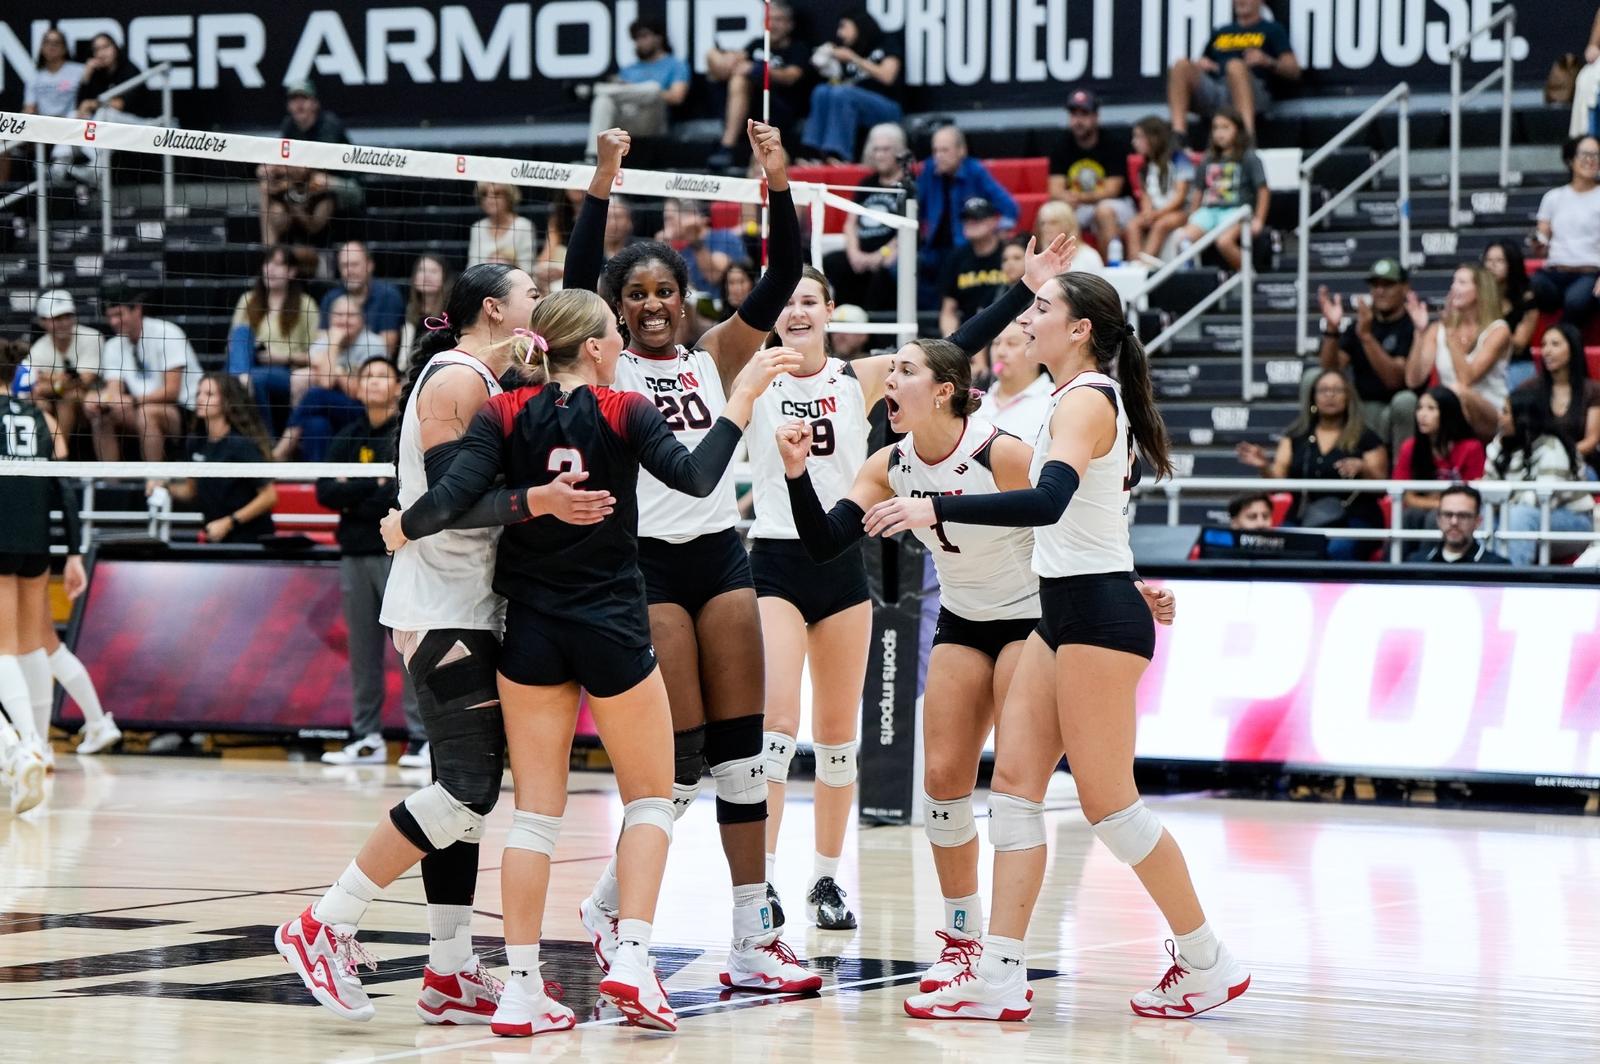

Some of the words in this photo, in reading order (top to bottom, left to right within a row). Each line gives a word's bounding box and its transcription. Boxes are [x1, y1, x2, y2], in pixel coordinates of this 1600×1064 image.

[153, 129, 228, 153] Matadors
[342, 147, 407, 169] Matadors
[511, 162, 571, 182] Matadors
[665, 175, 721, 193] Matadors
[654, 392, 712, 431] 20
[781, 396, 837, 418] CSUN
[2, 414, 37, 456] 13
[808, 418, 836, 457] 9
